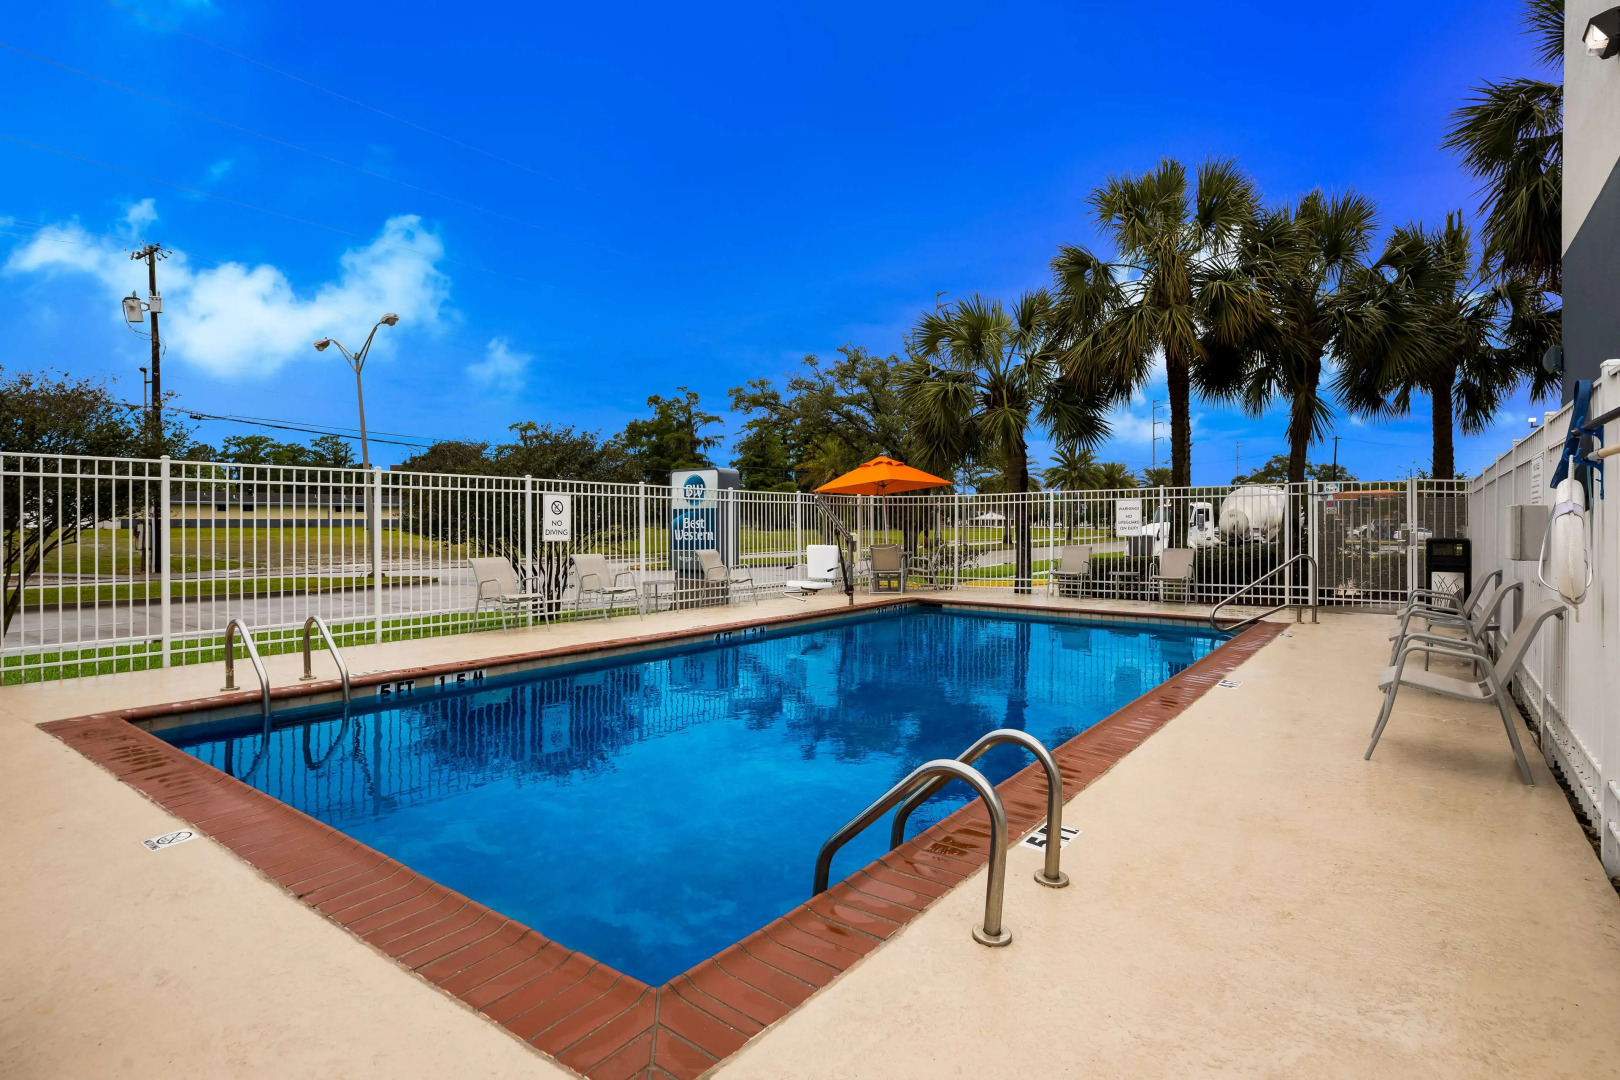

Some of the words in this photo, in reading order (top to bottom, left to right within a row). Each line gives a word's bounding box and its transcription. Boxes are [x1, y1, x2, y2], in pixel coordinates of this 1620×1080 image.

[685, 483, 704, 497] BW
[683, 517, 706, 529] Best
[545, 528, 569, 536] DIVING
[674, 529, 714, 541] Western
[380, 684, 392, 695] 5
[396, 680, 415, 693] FT
